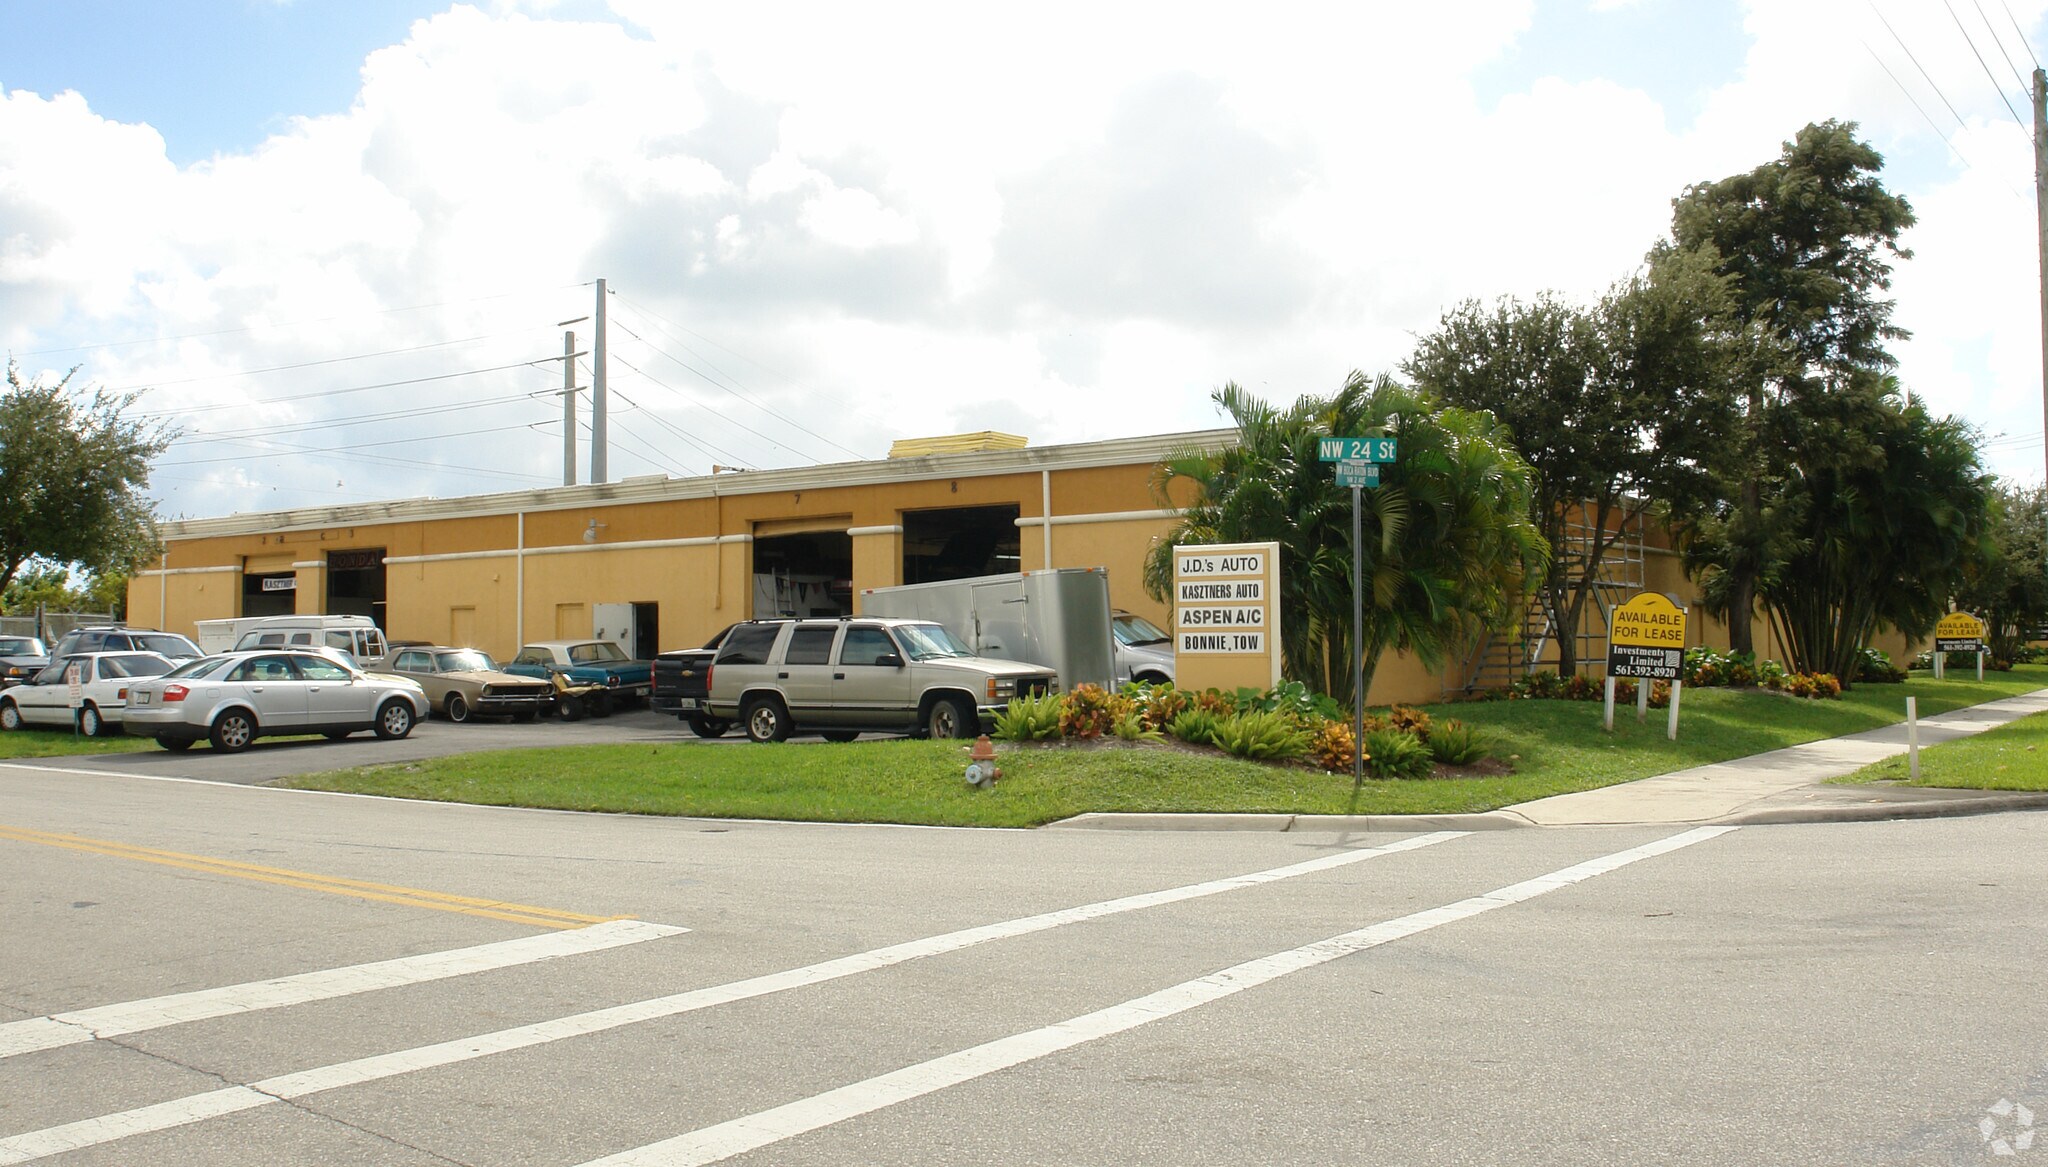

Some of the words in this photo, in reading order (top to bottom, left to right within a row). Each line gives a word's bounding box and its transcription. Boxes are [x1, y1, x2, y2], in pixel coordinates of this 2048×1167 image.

[1321, 441, 1344, 458] NW
[1351, 441, 1371, 458] 24
[1379, 441, 1395, 459] St
[951, 481, 958, 493] 8
[795, 494, 801, 504] 7
[1221, 557, 1258, 571] AUTO
[1182, 584, 1231, 599] KASZTNERS
[1236, 583, 1259, 598] AUTO
[1183, 609, 1231, 624] ASPEN
[1235, 609, 1261, 624] A/C
[1618, 611, 1681, 626] AVAILABLE
[1614, 626, 1639, 638] FOR
[1644, 628, 1682, 641] LEASE
[1233, 635, 1258, 650] TOW
[1613, 645, 1665, 656] Investments
[1630, 656, 1663, 667] Limited
[1615, 665, 1676, 677] 561-392-8920
